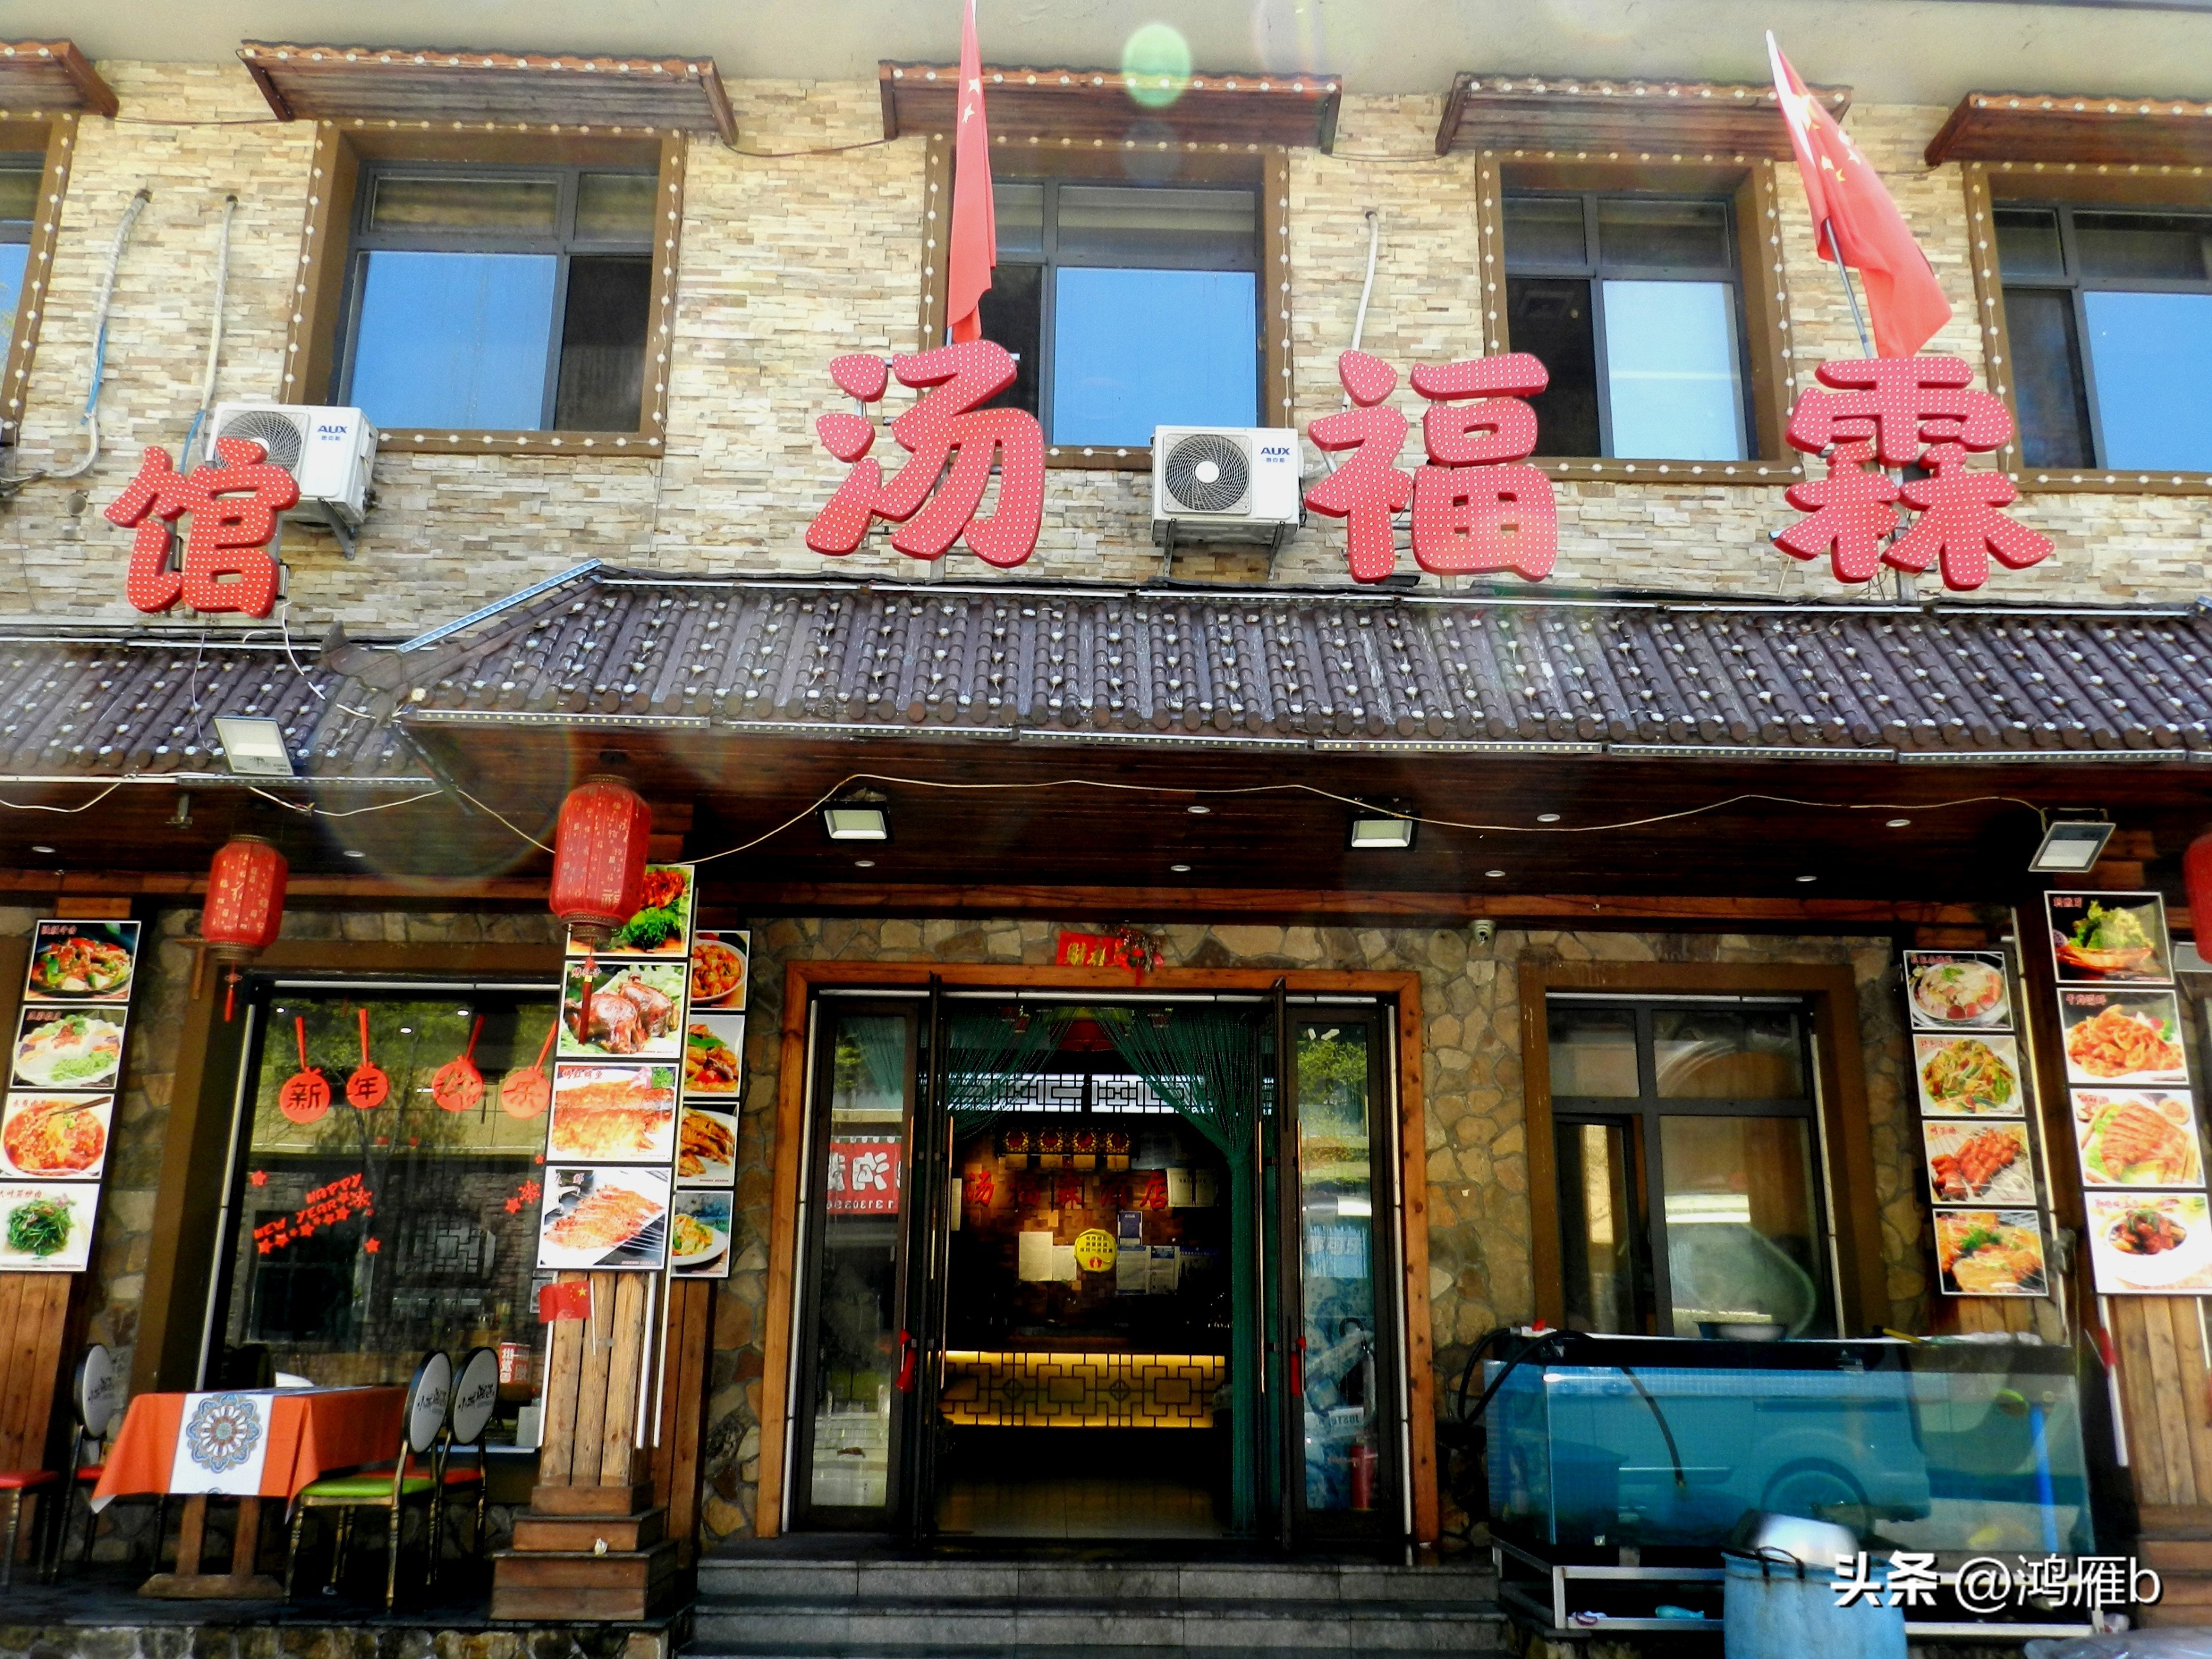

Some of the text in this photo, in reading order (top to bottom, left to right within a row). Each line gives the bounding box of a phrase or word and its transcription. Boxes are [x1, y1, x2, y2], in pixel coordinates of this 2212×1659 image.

[318, 425, 347, 434] AUX
[104, 436, 300, 619] 馆
[305, 1173, 363, 1204] HAPPY
[253, 1199, 337, 1240] NEW YEAR
